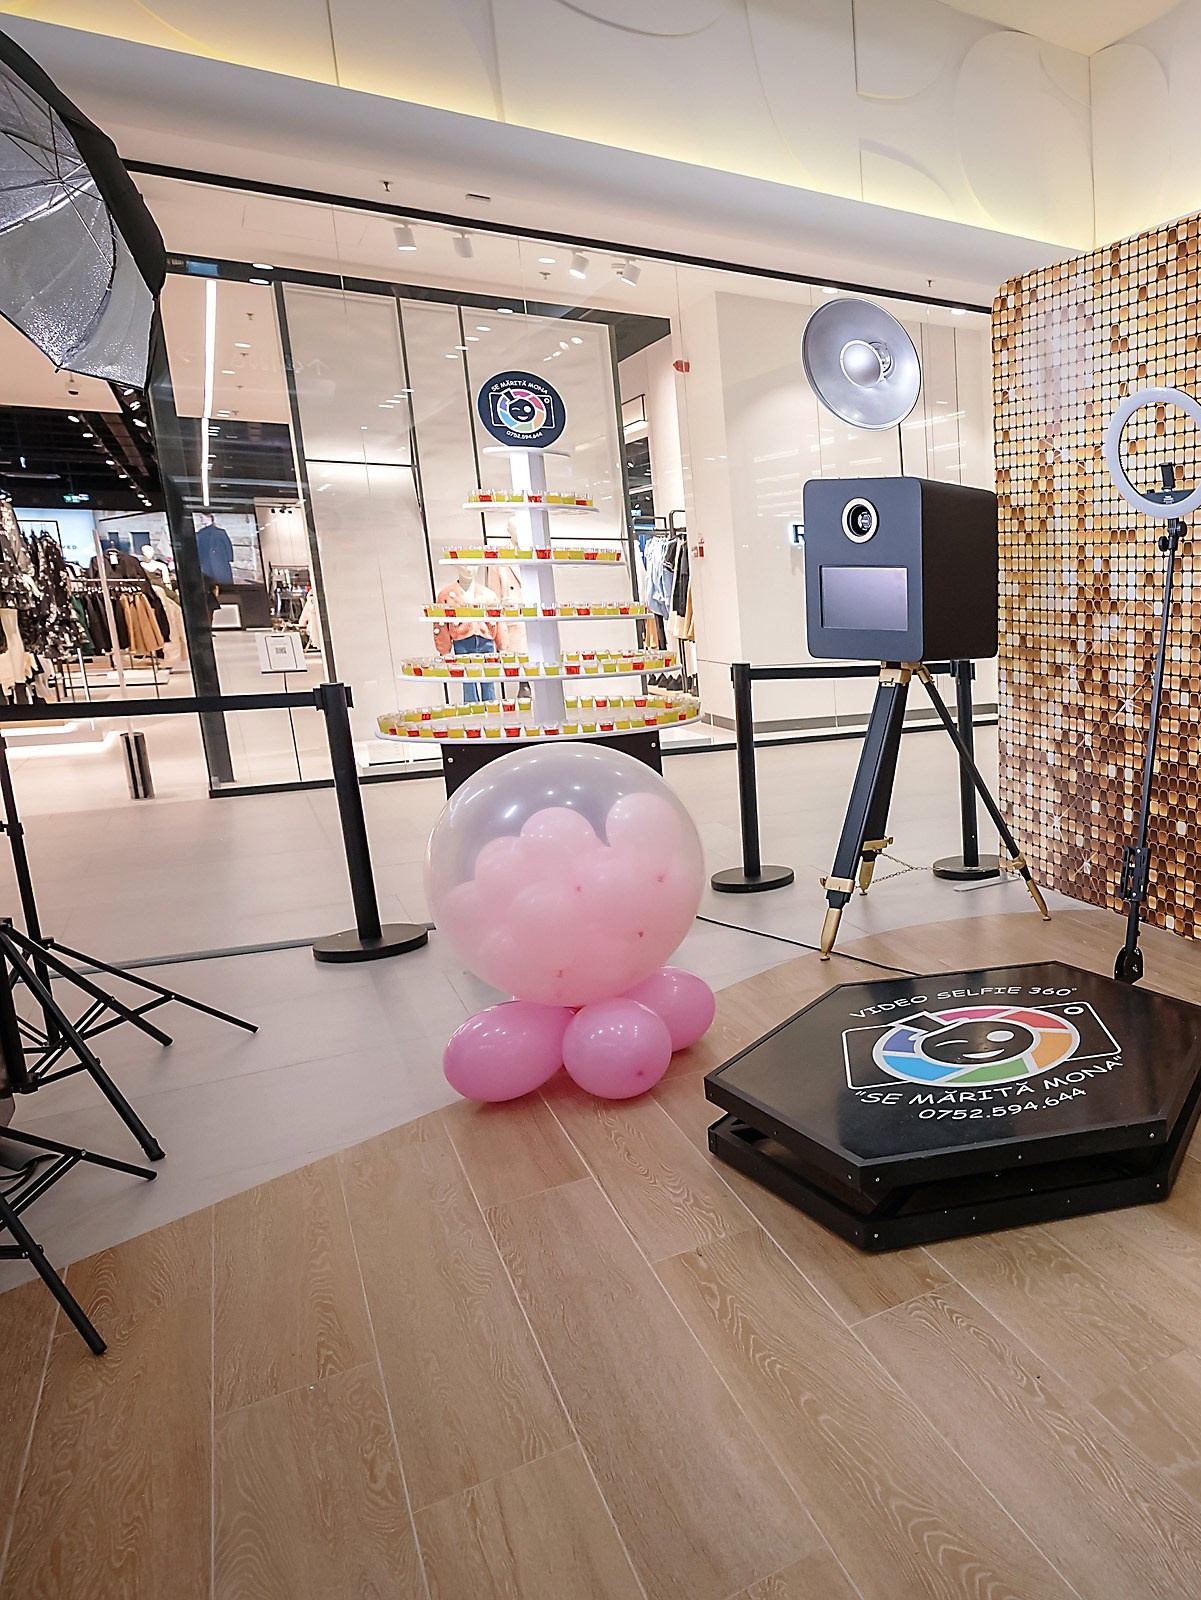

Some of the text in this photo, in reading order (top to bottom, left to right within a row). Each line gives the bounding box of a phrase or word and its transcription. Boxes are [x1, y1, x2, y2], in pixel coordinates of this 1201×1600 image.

[490, 382, 501, 392] SE
[527, 382, 548, 395] MONA
[849, 994, 928, 1020] VIDEO
[937, 986, 1022, 1000] SELFIE
[908, 1081, 1035, 1106] MĂRITĂ
[917, 1087, 1087, 1120] 0752.594.644
